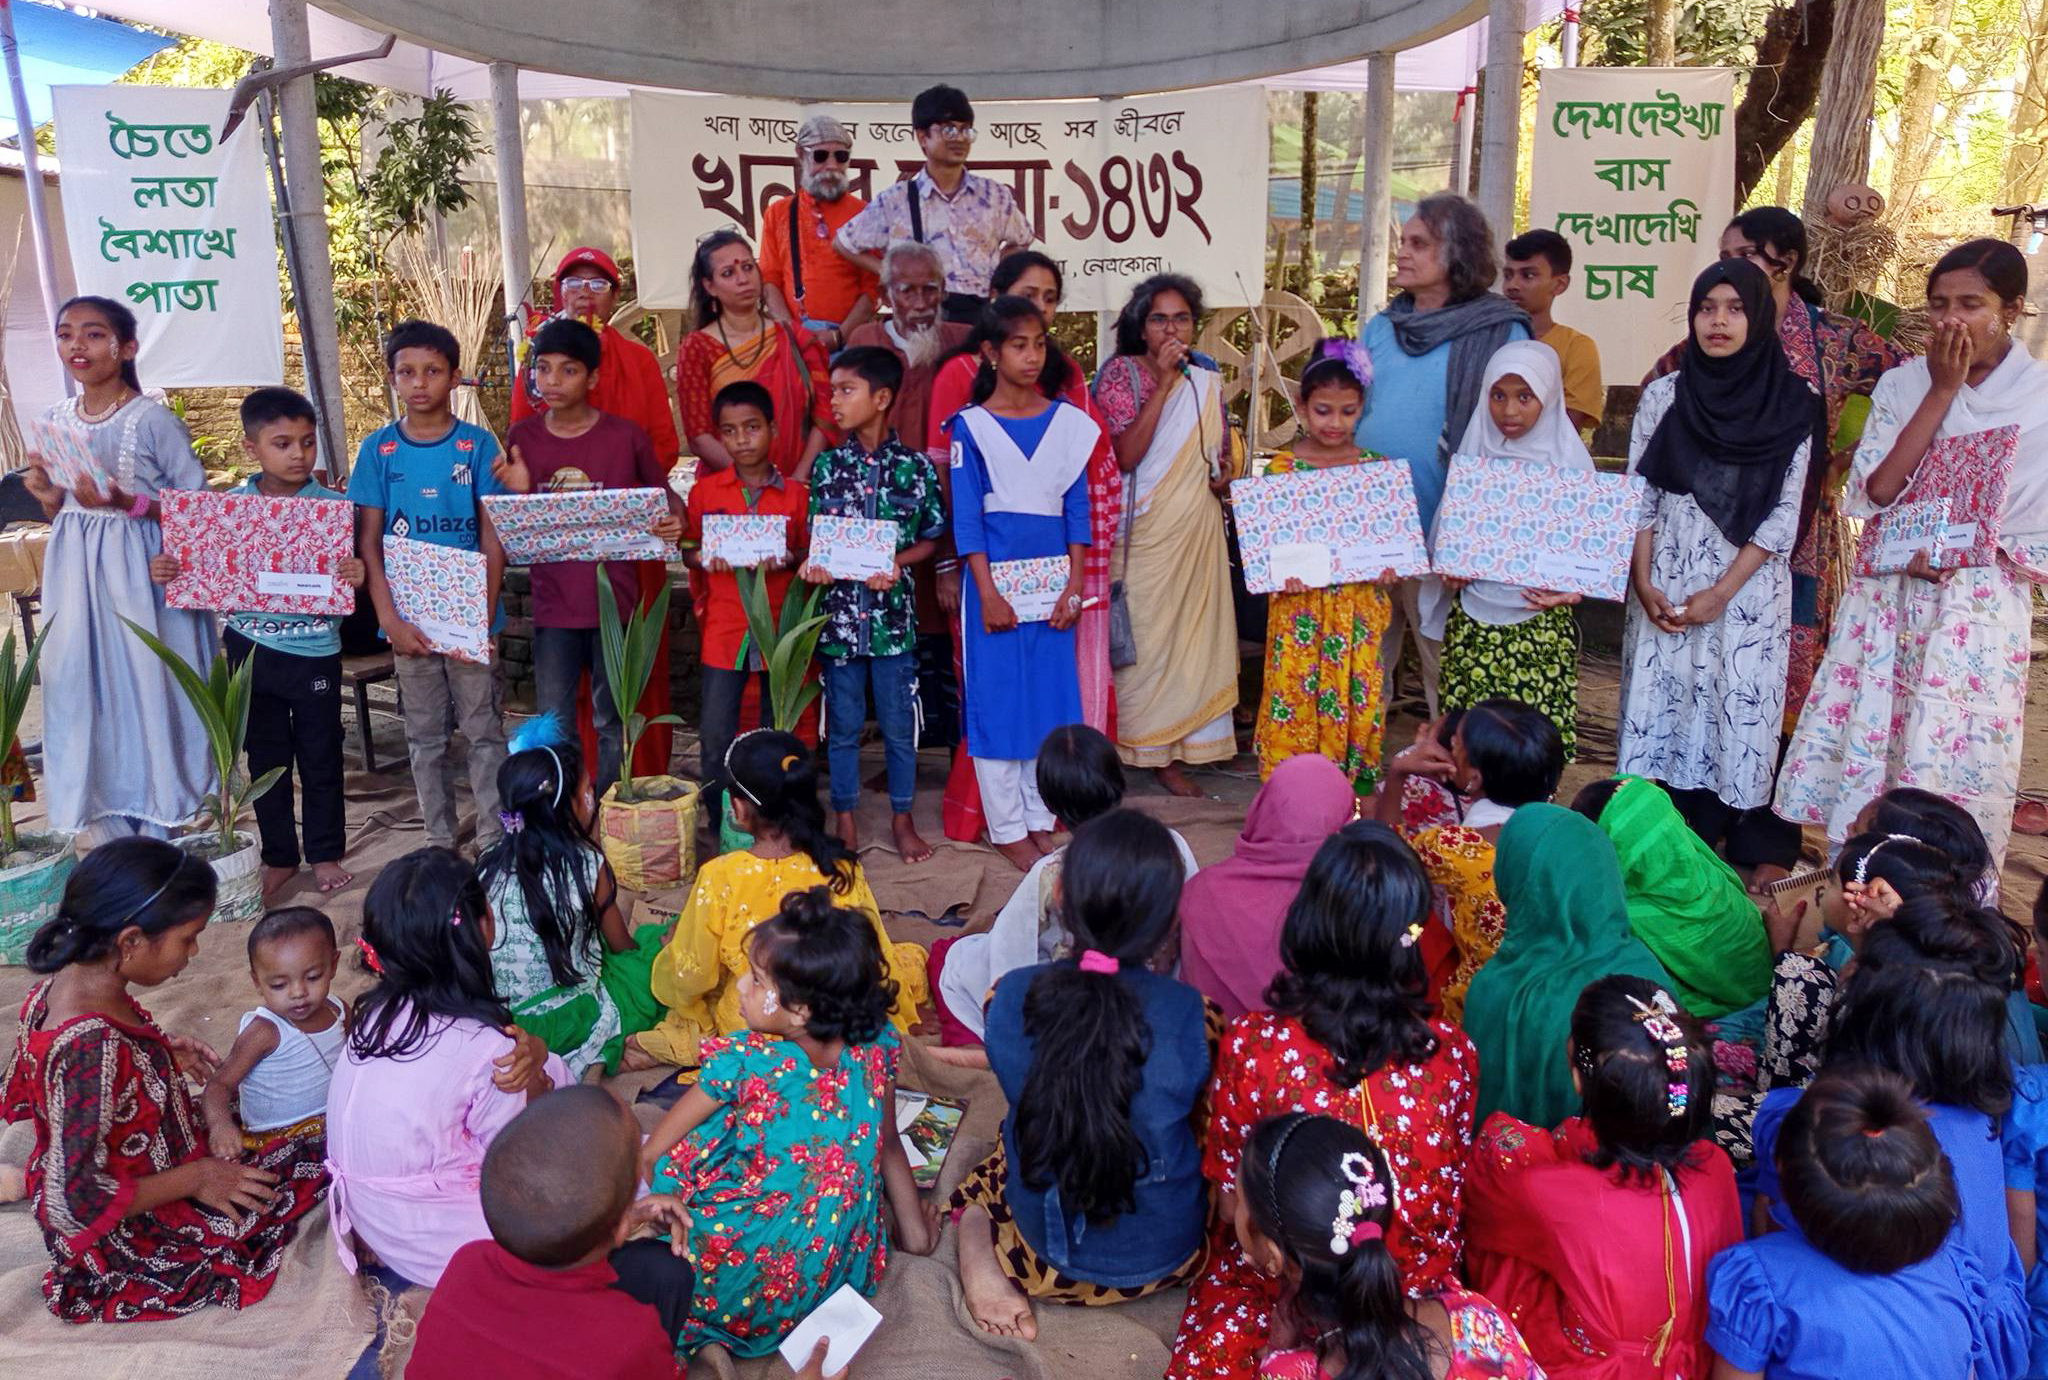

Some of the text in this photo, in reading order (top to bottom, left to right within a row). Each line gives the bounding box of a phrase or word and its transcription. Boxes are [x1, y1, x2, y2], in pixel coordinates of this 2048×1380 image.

[105, 110, 213, 159] চৈতে
[704, 115, 741, 142] খনা
[749, 117, 798, 144] আছে
[990, 122, 1048, 149] আছে
[1063, 119, 1099, 139] সব
[1113, 107, 1185, 142] জীবনে
[1552, 89, 1726, 141] দেশ দেইখ্যা
[131, 176, 218, 208] লতা
[1594, 158, 1671, 191] বাস
[98, 215, 237, 262] বৈশাখে
[1555, 198, 1702, 246] দেখাদেখি
[126, 279, 219, 313] পাতা
[1584, 264, 1658, 300] চাষ
[415, 514, 478, 533] blaze
